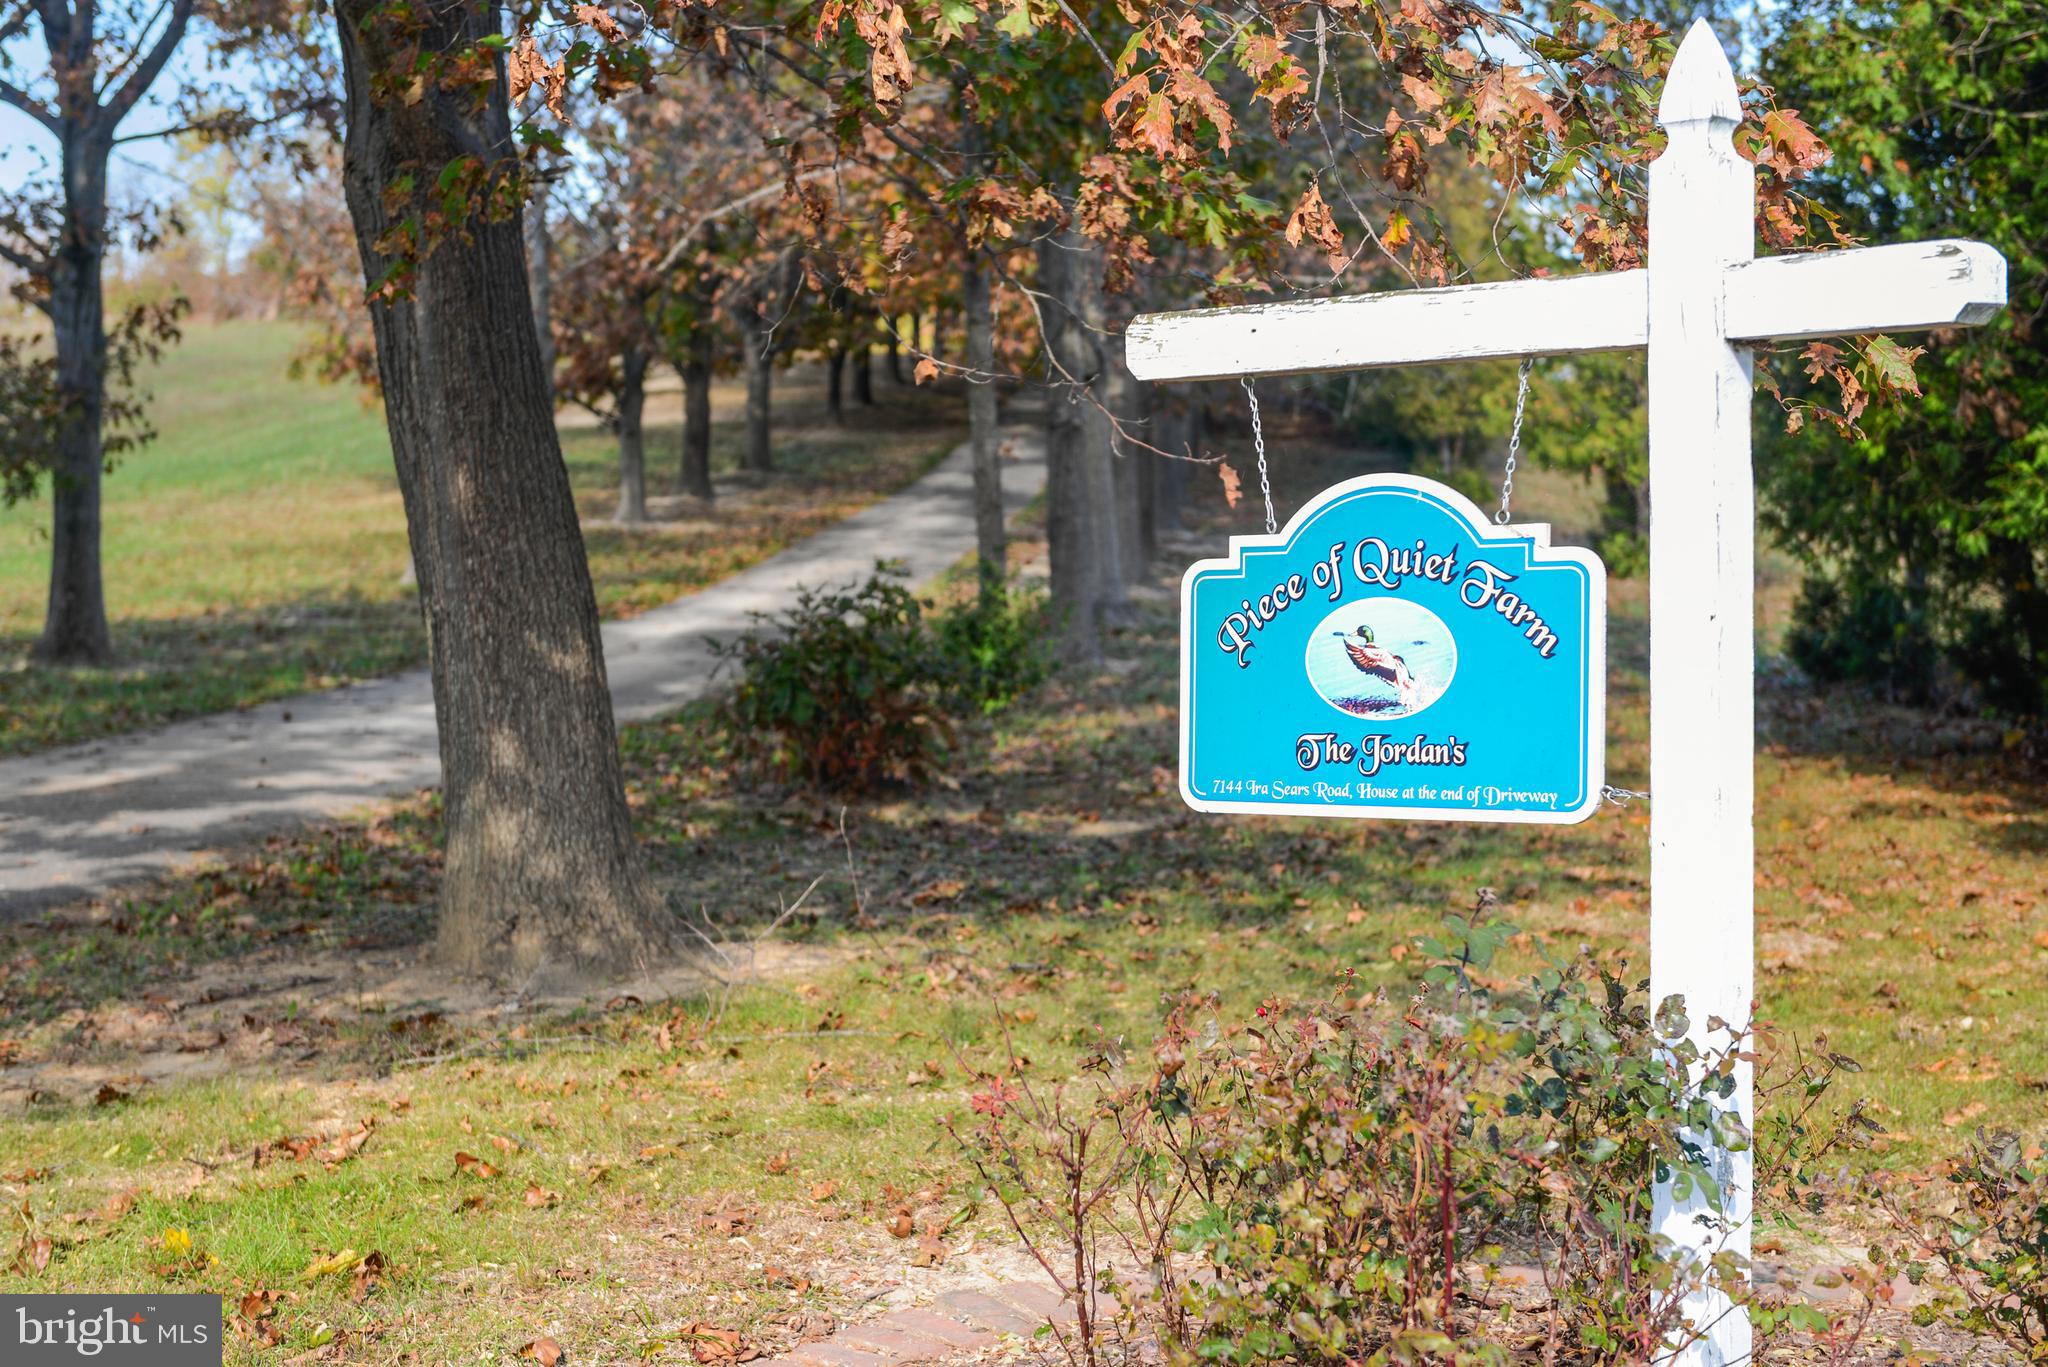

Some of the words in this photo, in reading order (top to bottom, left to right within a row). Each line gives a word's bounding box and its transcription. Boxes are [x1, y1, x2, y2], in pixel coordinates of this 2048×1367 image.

[1217, 573, 1307, 668] Piece
[1312, 541, 1346, 602] of
[1352, 537, 1460, 590] Quiet
[1460, 559, 1558, 660] Farm
[1296, 732, 1357, 771] The
[1358, 733, 1469, 777] Jordan's
[1213, 780, 1242, 794] 7144
[1246, 780, 1268, 795] Ira
[1272, 781, 1309, 799] Sears
[1313, 782, 1352, 802] Road,
[1357, 783, 1398, 799] House
[1402, 785, 1414, 799] at
[1418, 785, 1436, 799] the
[1441, 786, 1464, 800] end
[1467, 786, 1481, 807] of
[1483, 786, 1557, 809] Driveway
